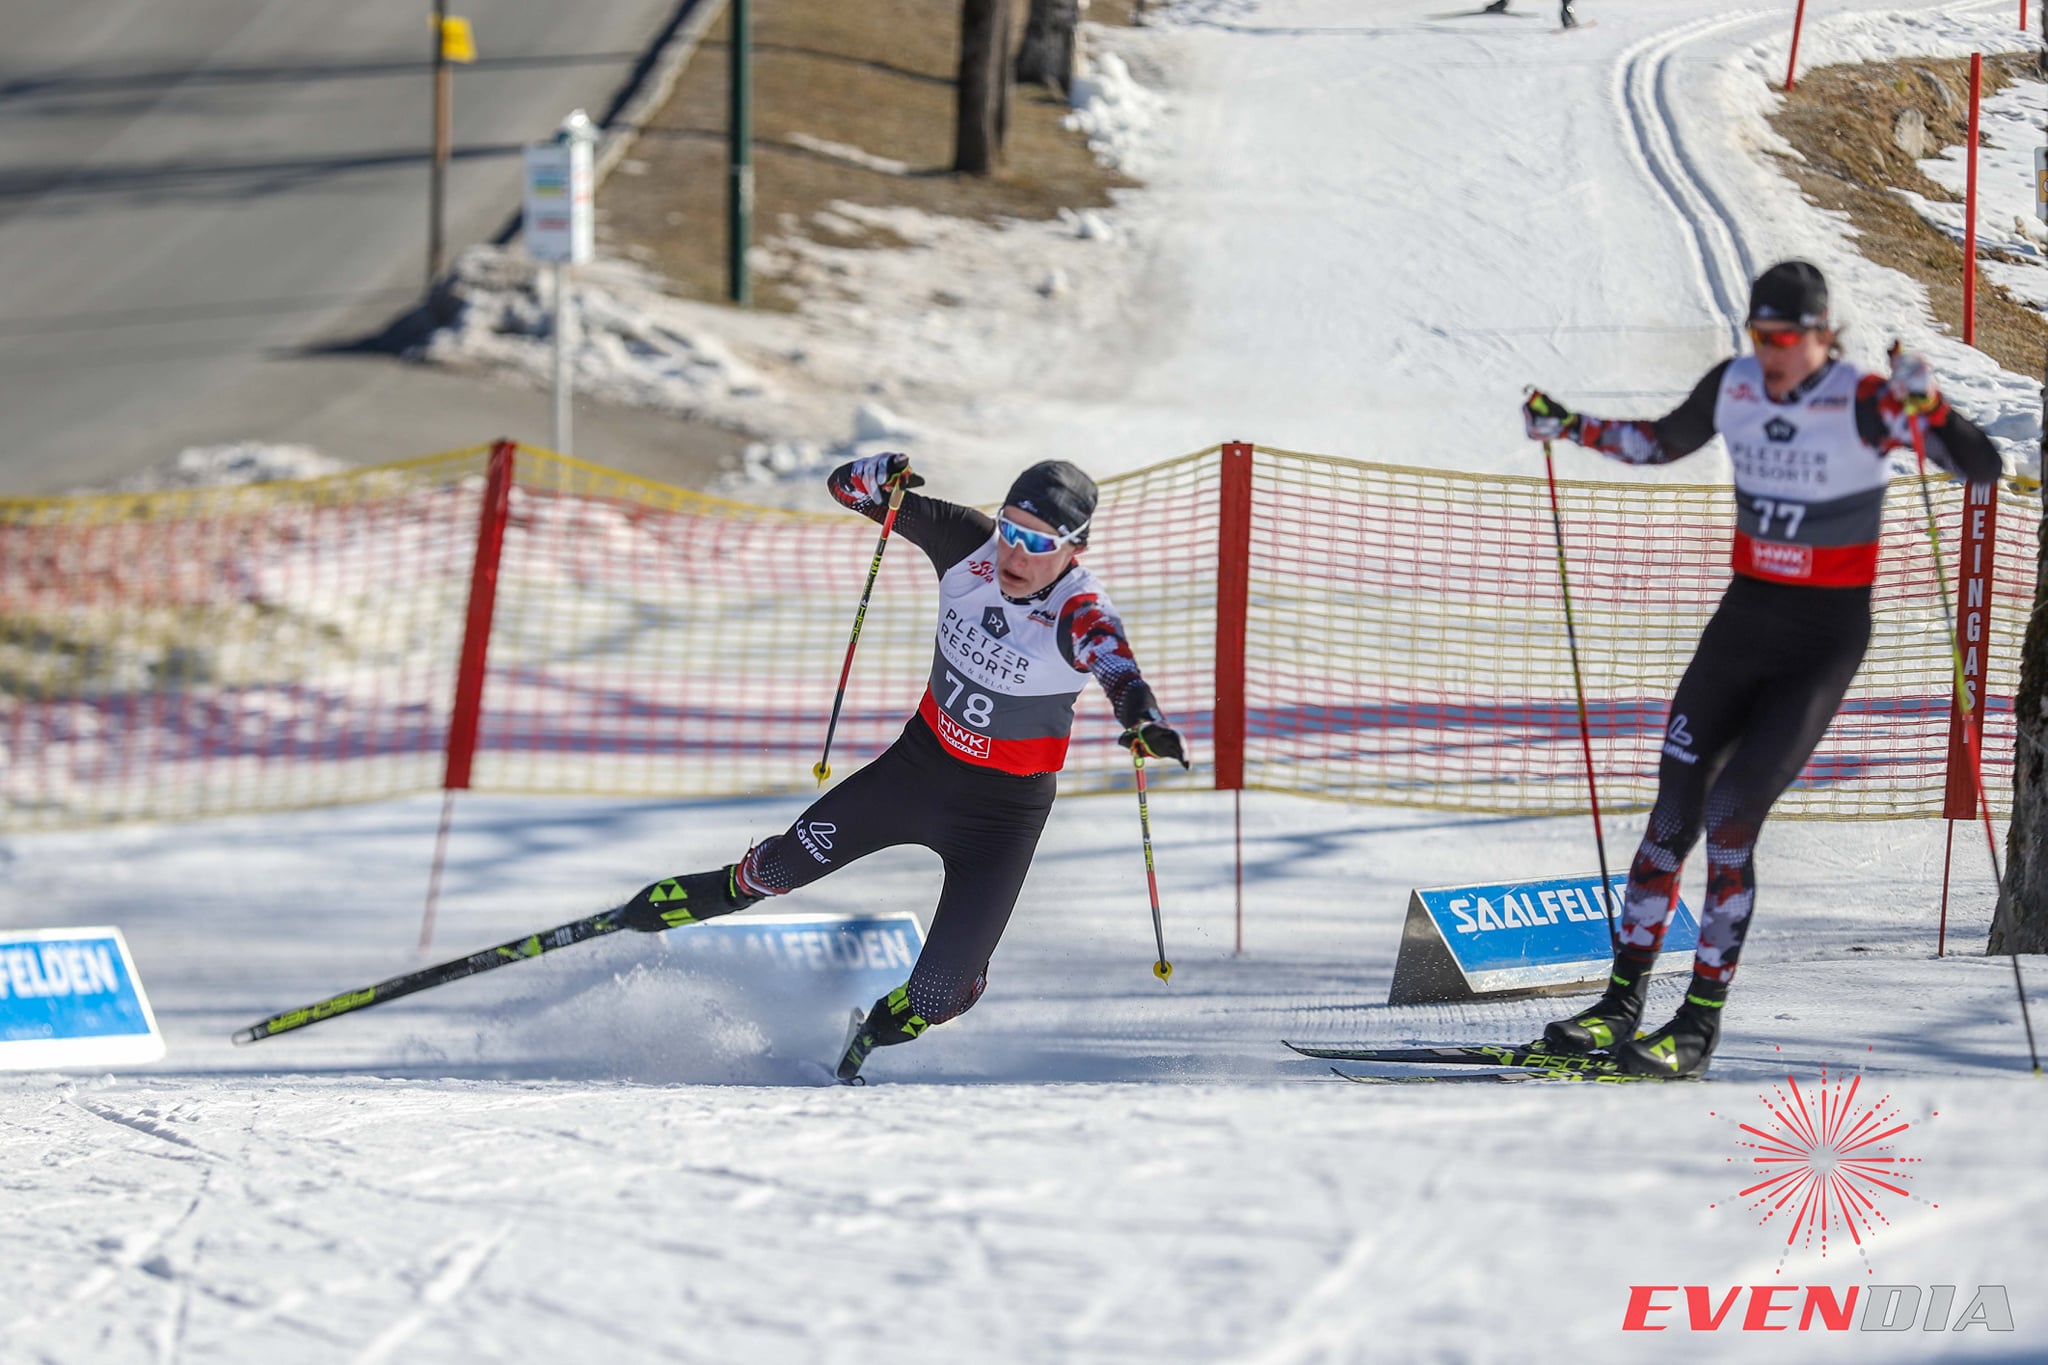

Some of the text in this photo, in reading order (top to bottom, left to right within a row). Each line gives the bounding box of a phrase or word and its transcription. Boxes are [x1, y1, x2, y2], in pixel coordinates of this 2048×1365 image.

[1752, 499, 1806, 539] 77
[941, 622, 1026, 684] RESORTS
[946, 608, 1029, 671] PLETZER
[945, 669, 994, 728] 78
[978, 673, 1012, 692] RELAX
[941, 713, 985, 750] HWK
[796, 820, 832, 864] Löffler
